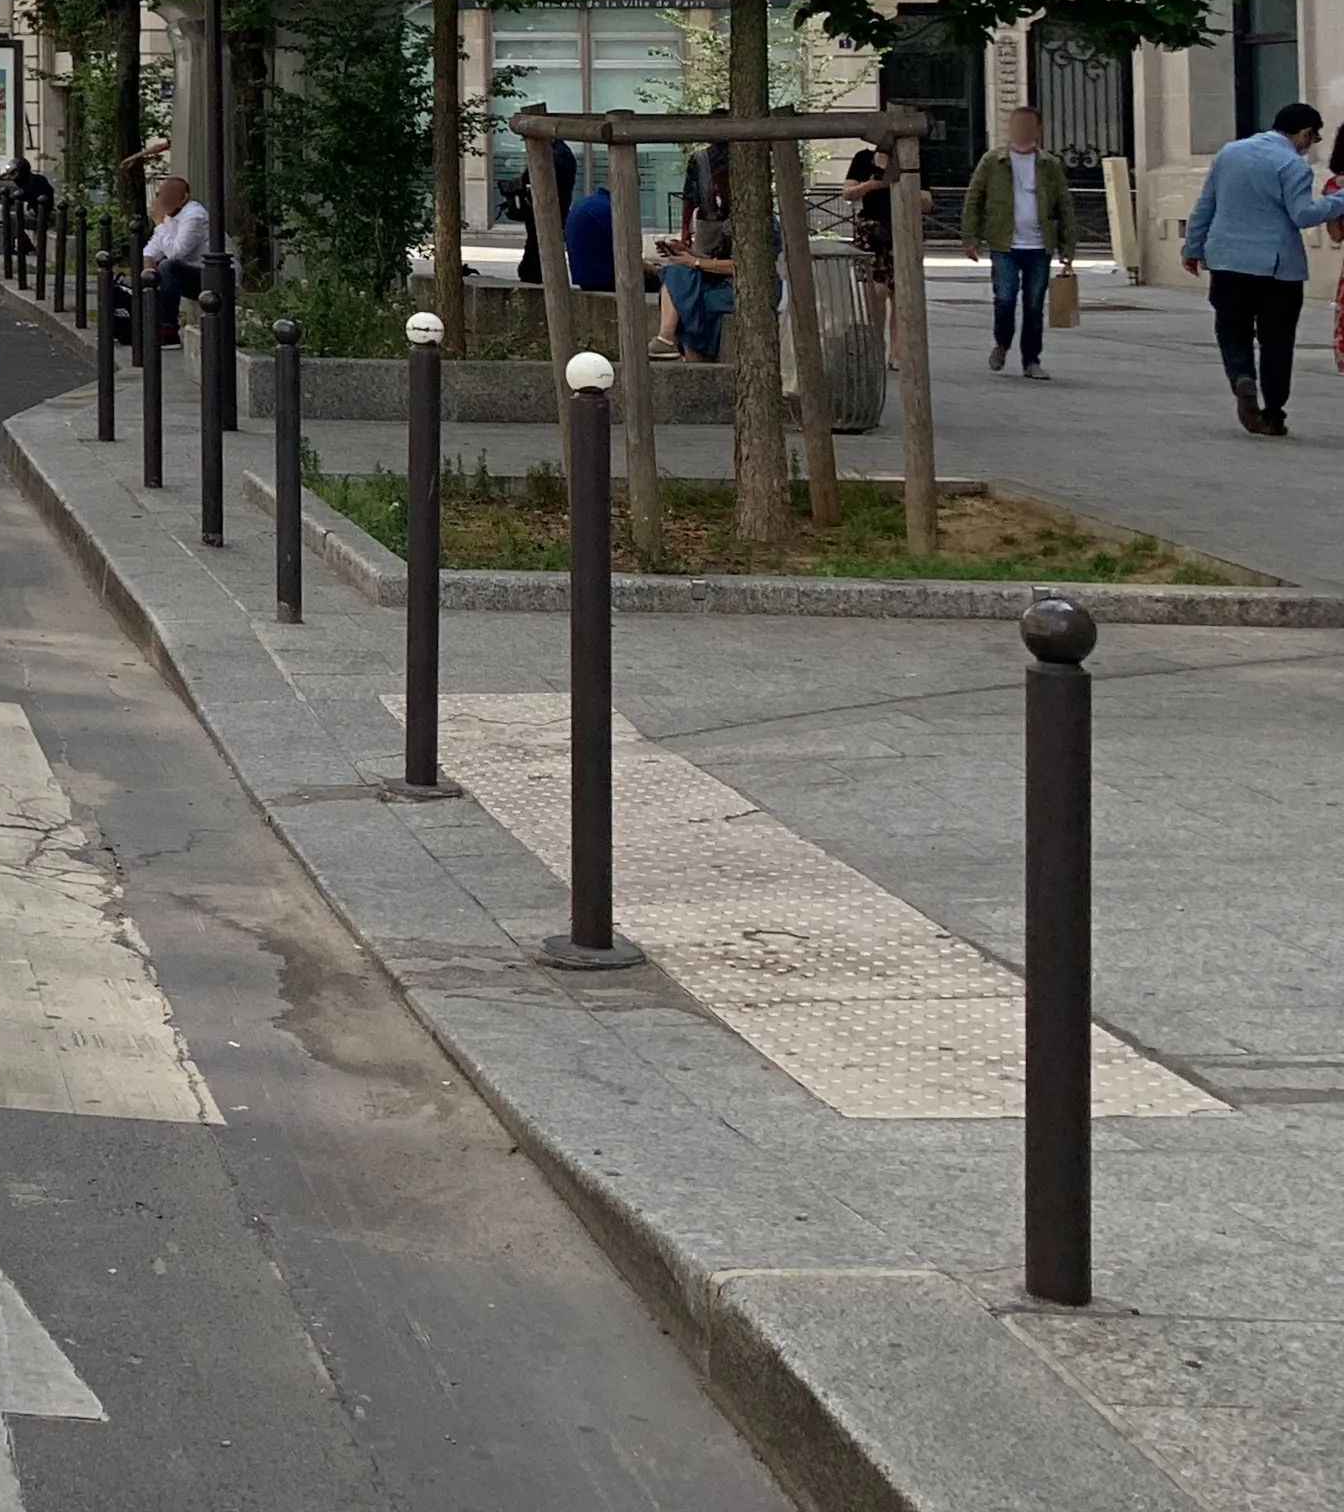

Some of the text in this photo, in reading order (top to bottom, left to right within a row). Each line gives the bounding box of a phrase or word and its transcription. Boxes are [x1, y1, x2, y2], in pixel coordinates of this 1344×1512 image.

[586, 0, 601, 8] de
[605, 0, 617, 8] la
[622, 0, 650, 8] Ville
[656, 0, 670, 8] de
[675, 0, 706, 8] Paris
